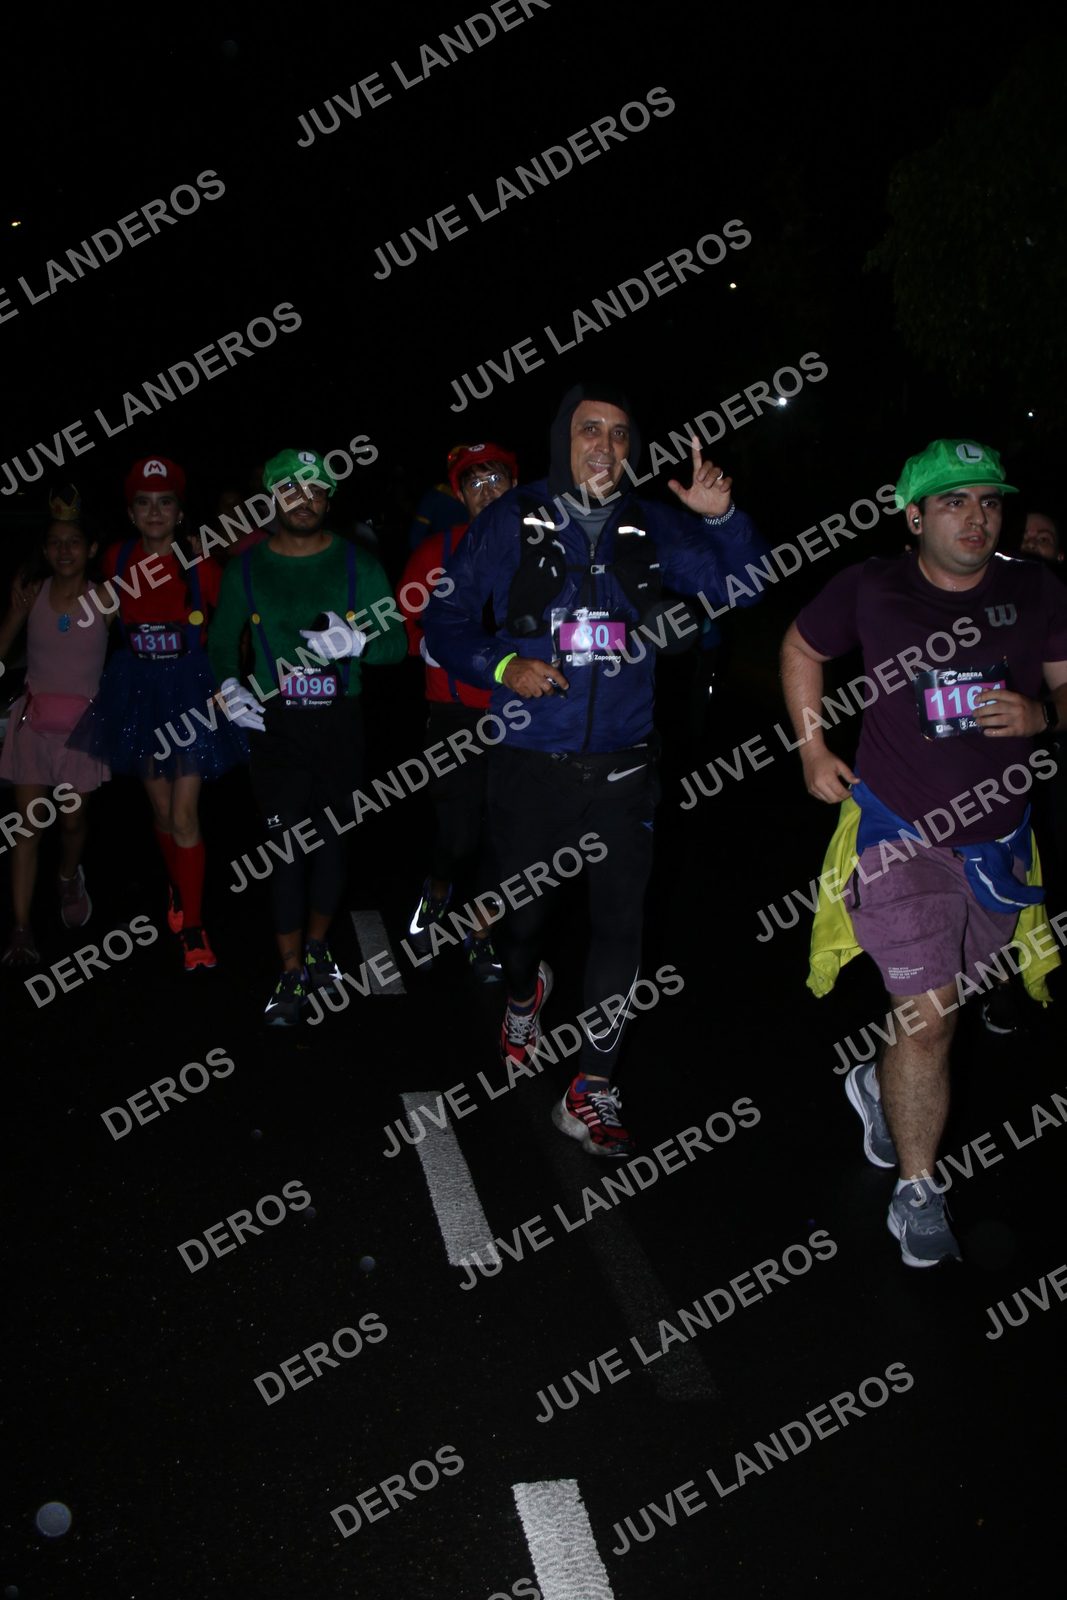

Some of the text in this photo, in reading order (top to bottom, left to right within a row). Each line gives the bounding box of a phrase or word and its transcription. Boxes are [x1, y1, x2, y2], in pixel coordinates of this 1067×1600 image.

[963, 445, 980, 459] L
[134, 633, 177, 651] 1311
[284, 676, 335, 696] 1096
